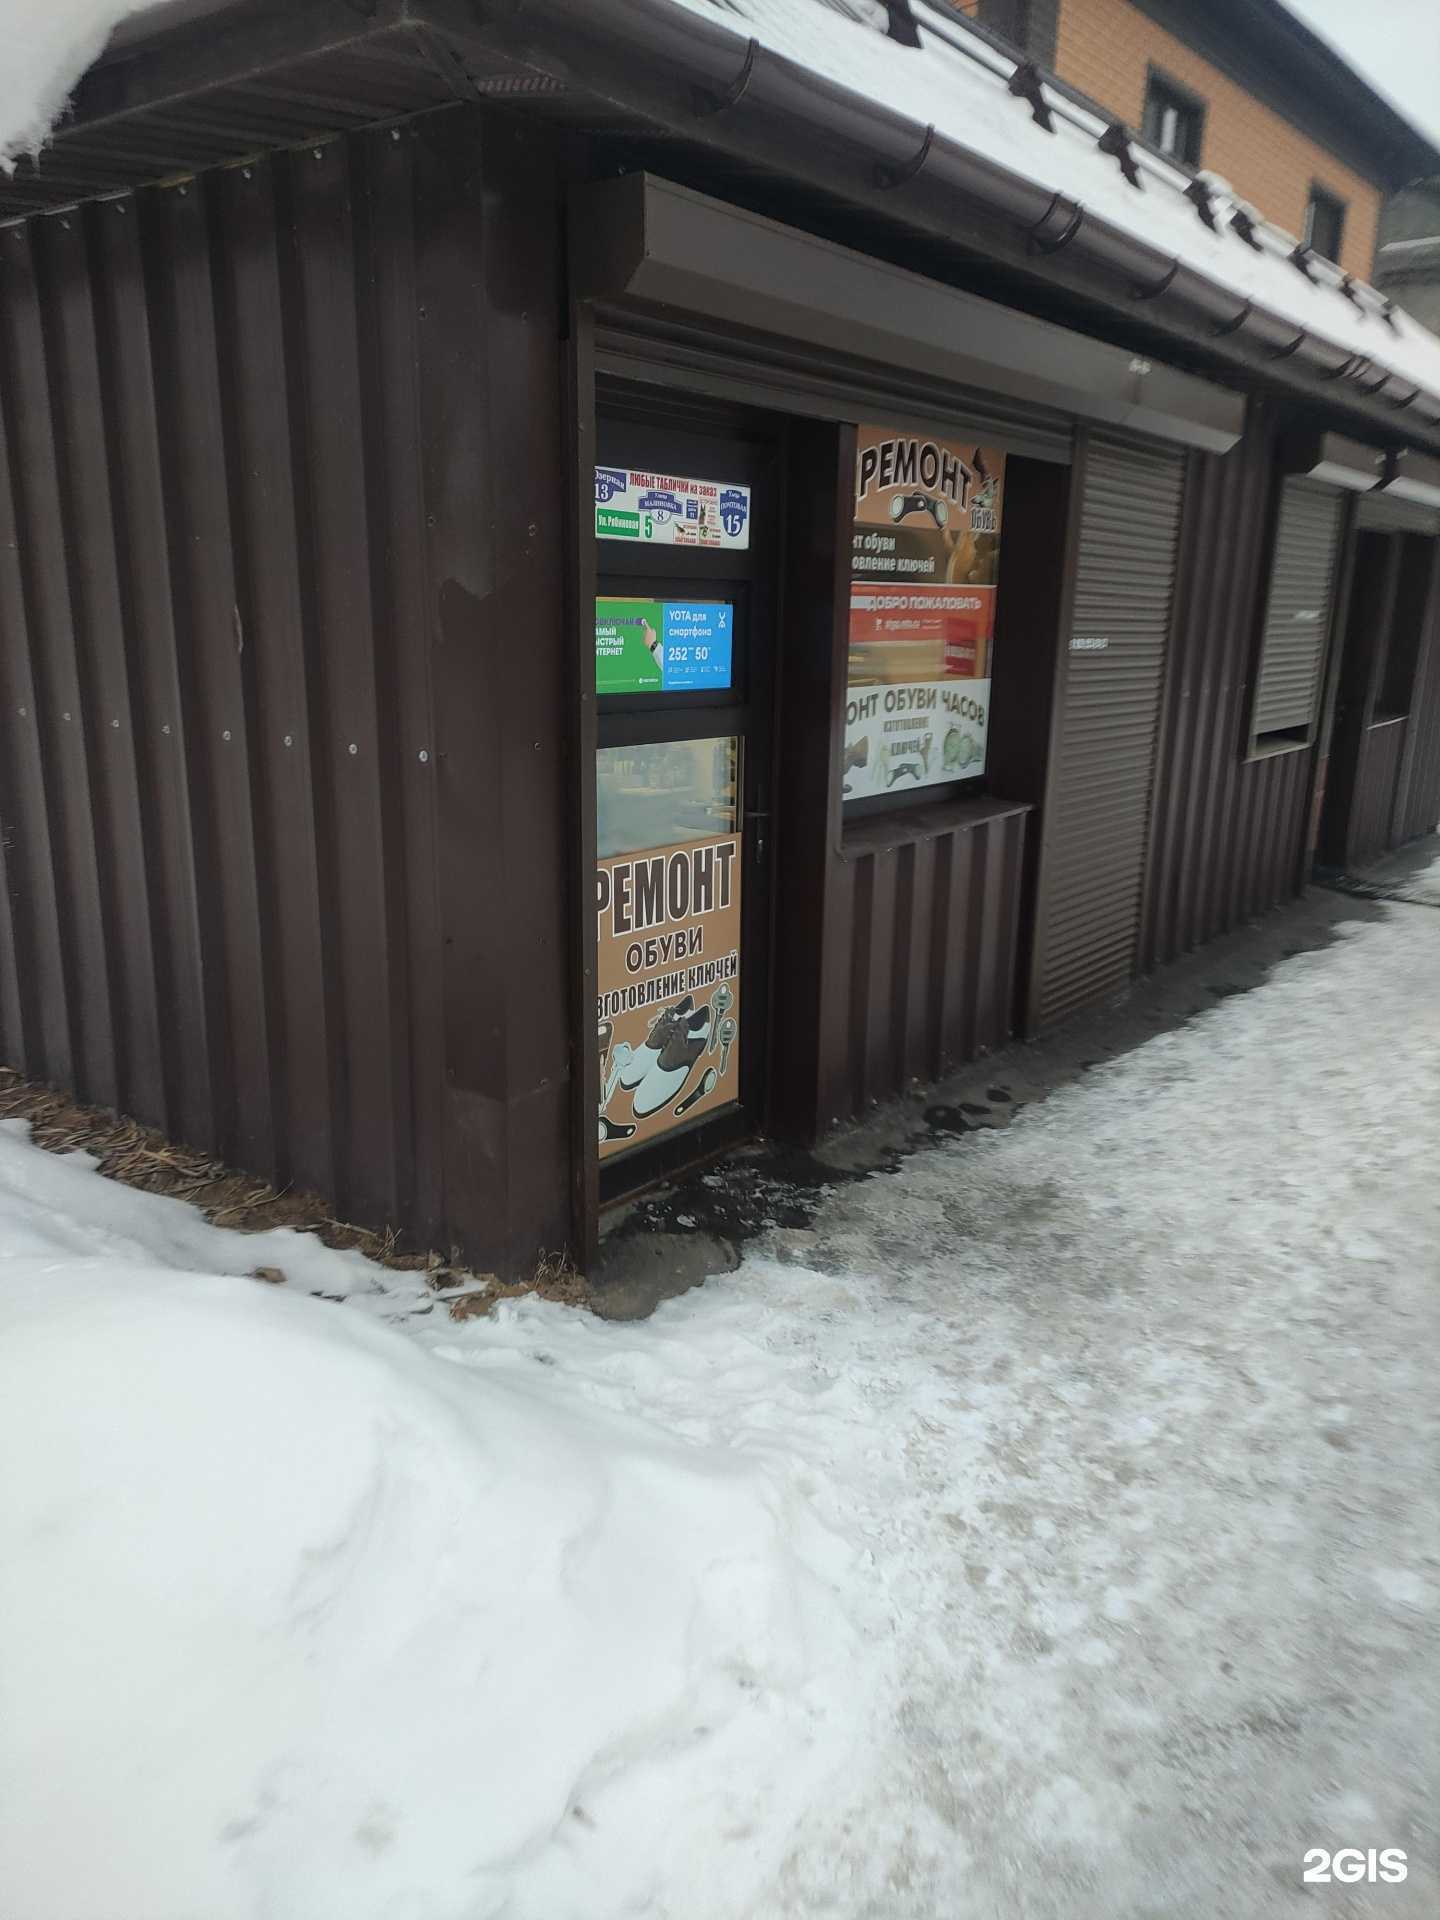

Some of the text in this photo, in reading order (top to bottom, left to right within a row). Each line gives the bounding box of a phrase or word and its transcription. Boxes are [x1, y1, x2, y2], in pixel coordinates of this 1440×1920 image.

[630, 472, 655, 489] ЛЮБЫЕ
[656, 477, 689, 494] ТАБЛИЧКИ
[859, 439, 973, 513] РЕМОНТ
[595, 483, 609, 500] 13
[657, 510, 664, 521] 8
[727, 514, 741, 535] 15
[645, 515, 653, 538] 5
[864, 532, 896, 553] обуви
[896, 556, 935, 573] ключей
[866, 595, 982, 611] ДОБРО ПОЖАЛОВАТЬ
[669, 610, 691, 621] YOTA
[669, 627, 712, 640] смартфона
[668, 646, 709, 661] 252 50
[884, 687, 937, 713] ОБУВИ
[942, 690, 985, 727] ЧАСОВ
[597, 841, 736, 942] РЕМОНТ
[625, 925, 704, 975] ОБУВИ
[687, 950, 738, 991] КЛЮЧЕЙ
